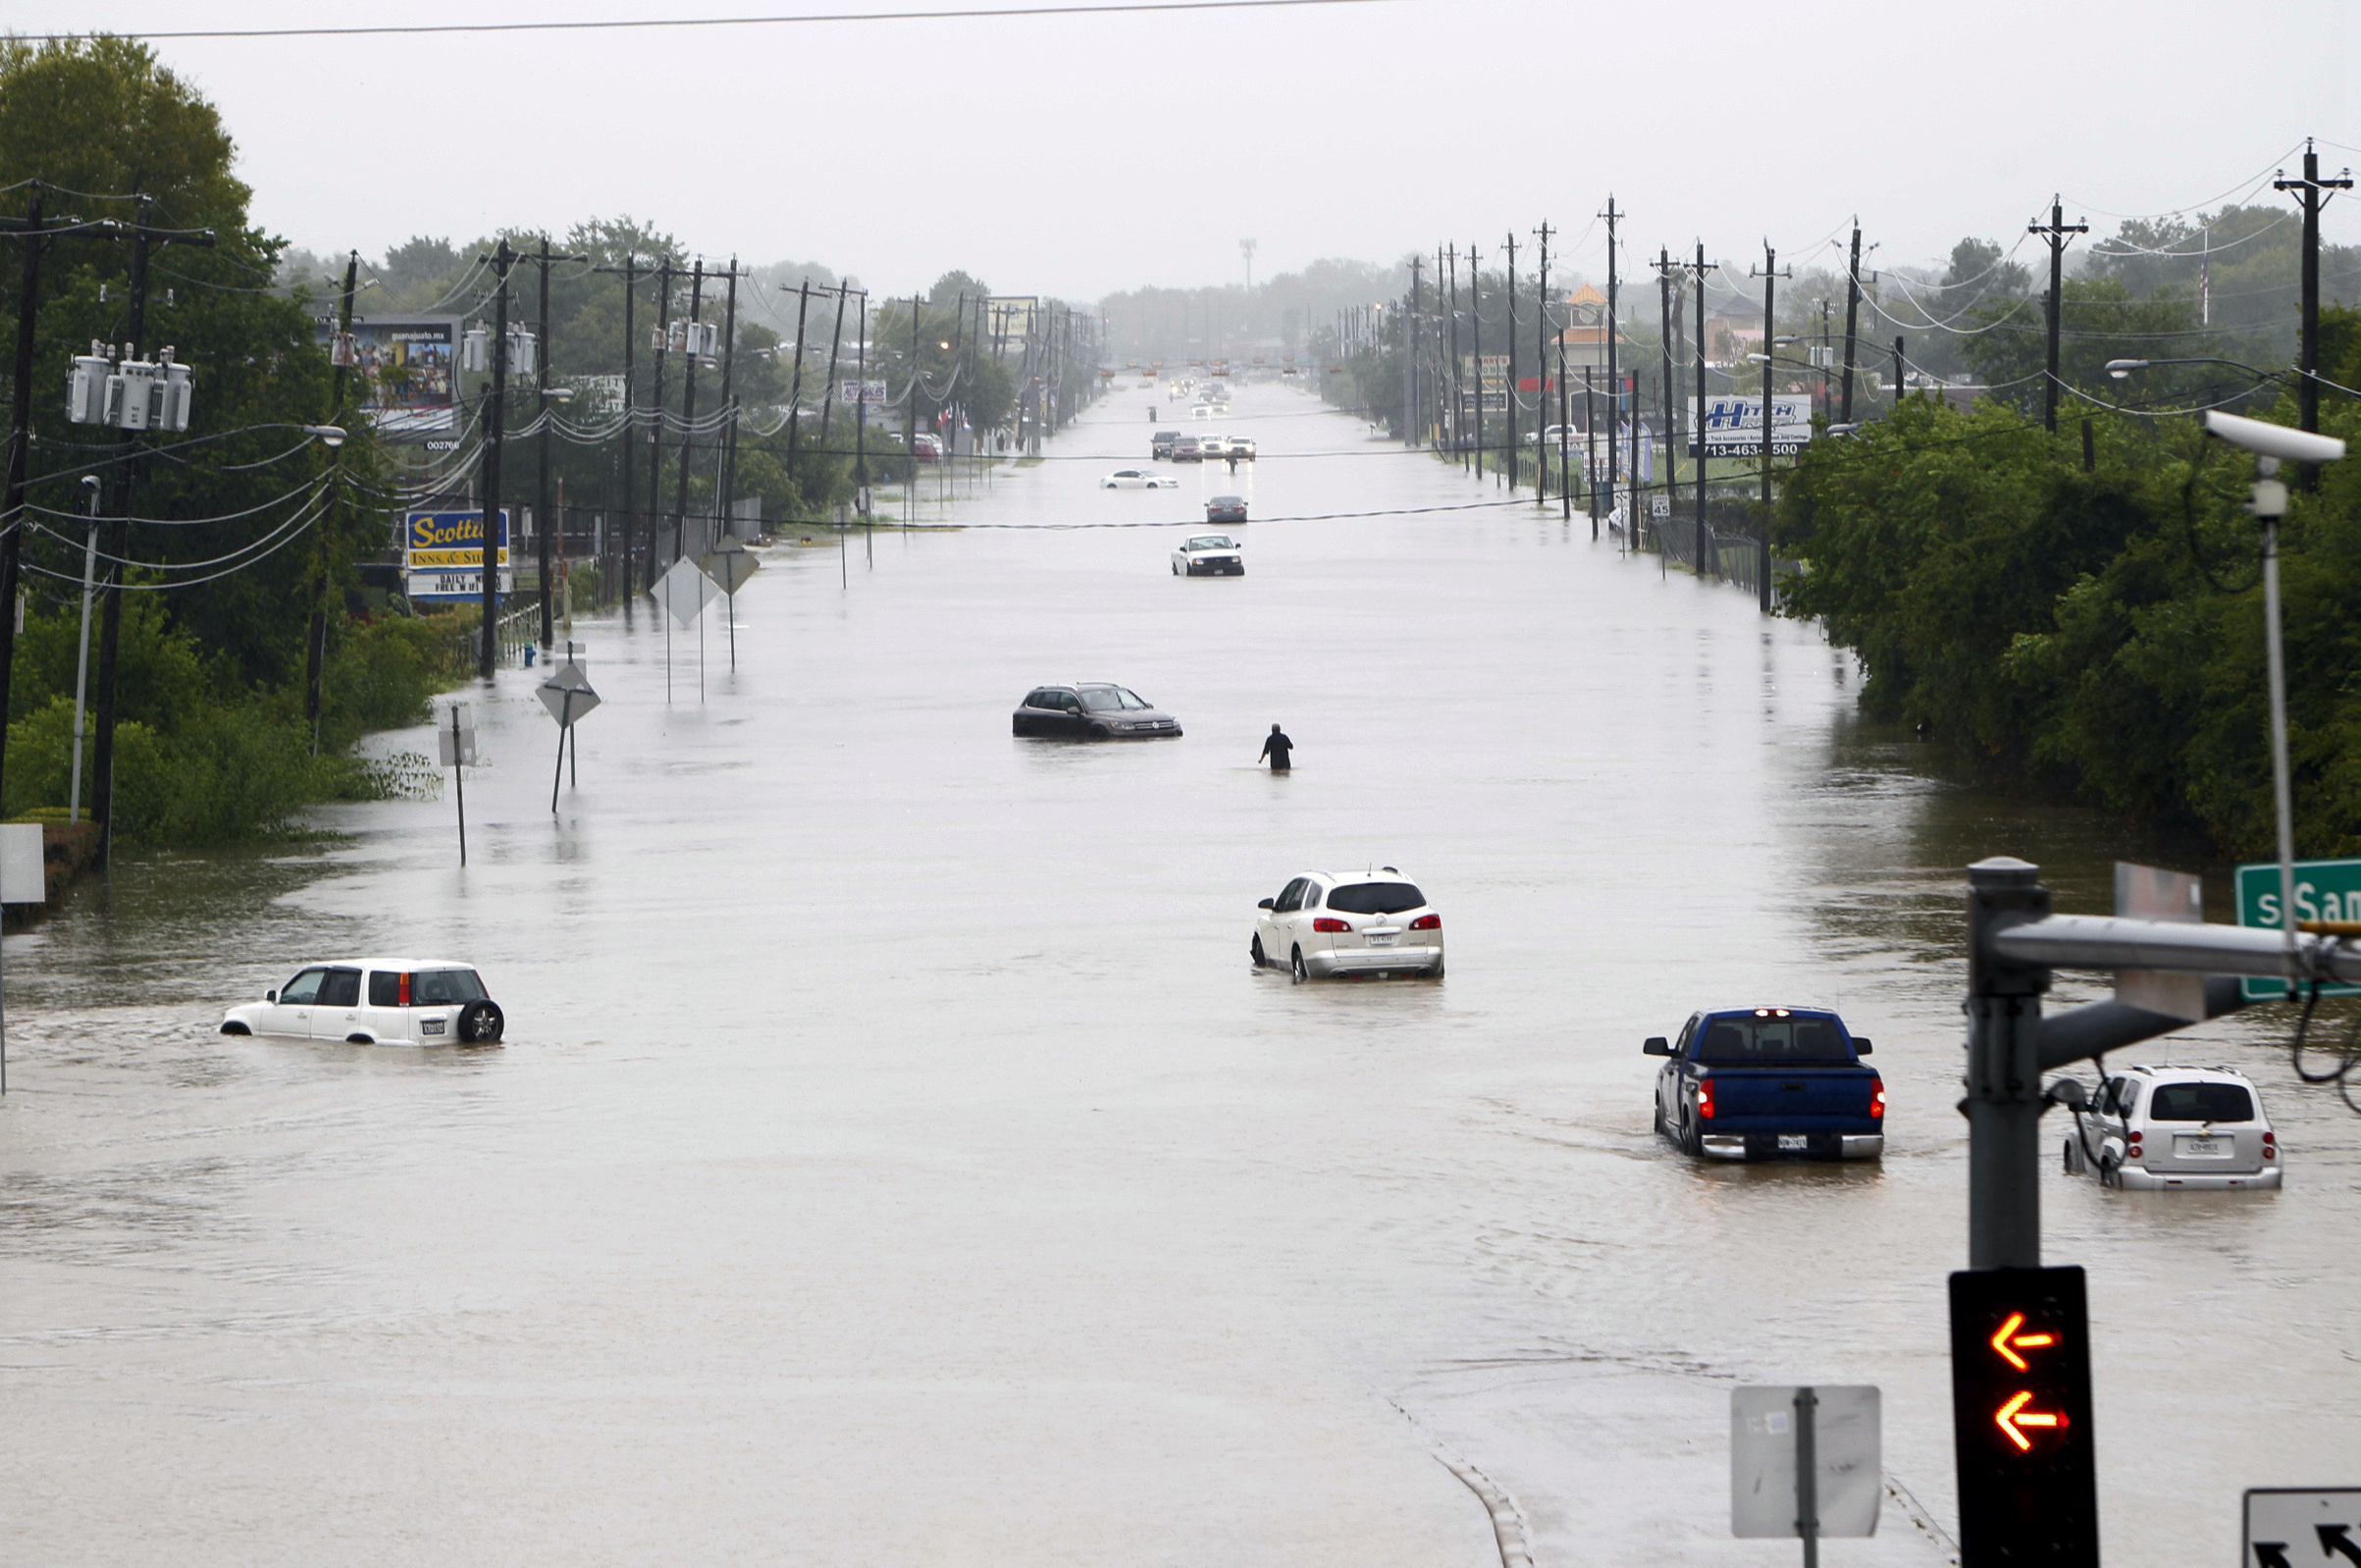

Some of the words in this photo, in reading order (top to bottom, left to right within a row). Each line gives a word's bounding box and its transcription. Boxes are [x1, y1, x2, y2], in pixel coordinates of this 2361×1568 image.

[392, 331, 445, 342] guanajuato.mx
[1654, 505, 1669, 514] 45
[441, 575, 465, 584] DAILY
[436, 583, 455, 592] FREE
